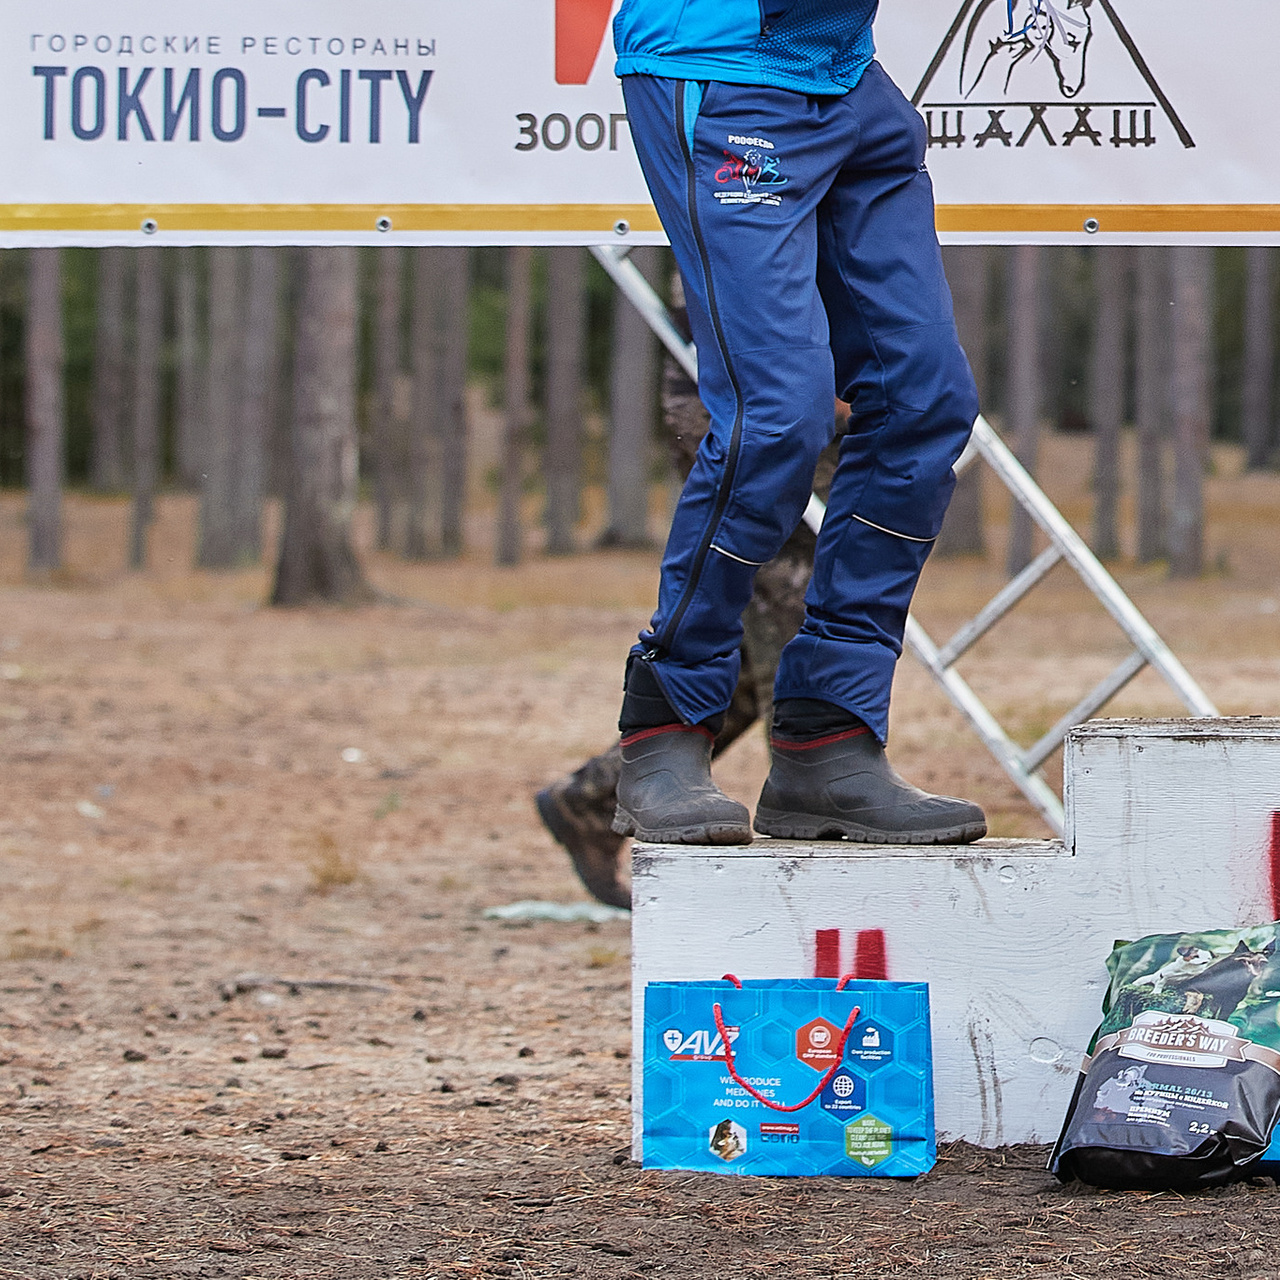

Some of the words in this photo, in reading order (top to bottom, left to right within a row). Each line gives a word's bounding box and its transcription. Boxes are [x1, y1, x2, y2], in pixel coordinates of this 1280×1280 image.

[31, 34, 221, 55] ГОРОДСКИЕ
[241, 37, 437, 56] РЕСТОРАНЫ
[926, 106, 1156, 148] ШАЛАШ
[1127, 1027, 1197, 1047] BREEDER'S
[1199, 1036, 1229, 1052] WAY
[741, 1077, 782, 1087] RODUCE
[713, 1098, 734, 1107] AND
[735, 1099, 749, 1108] DO
